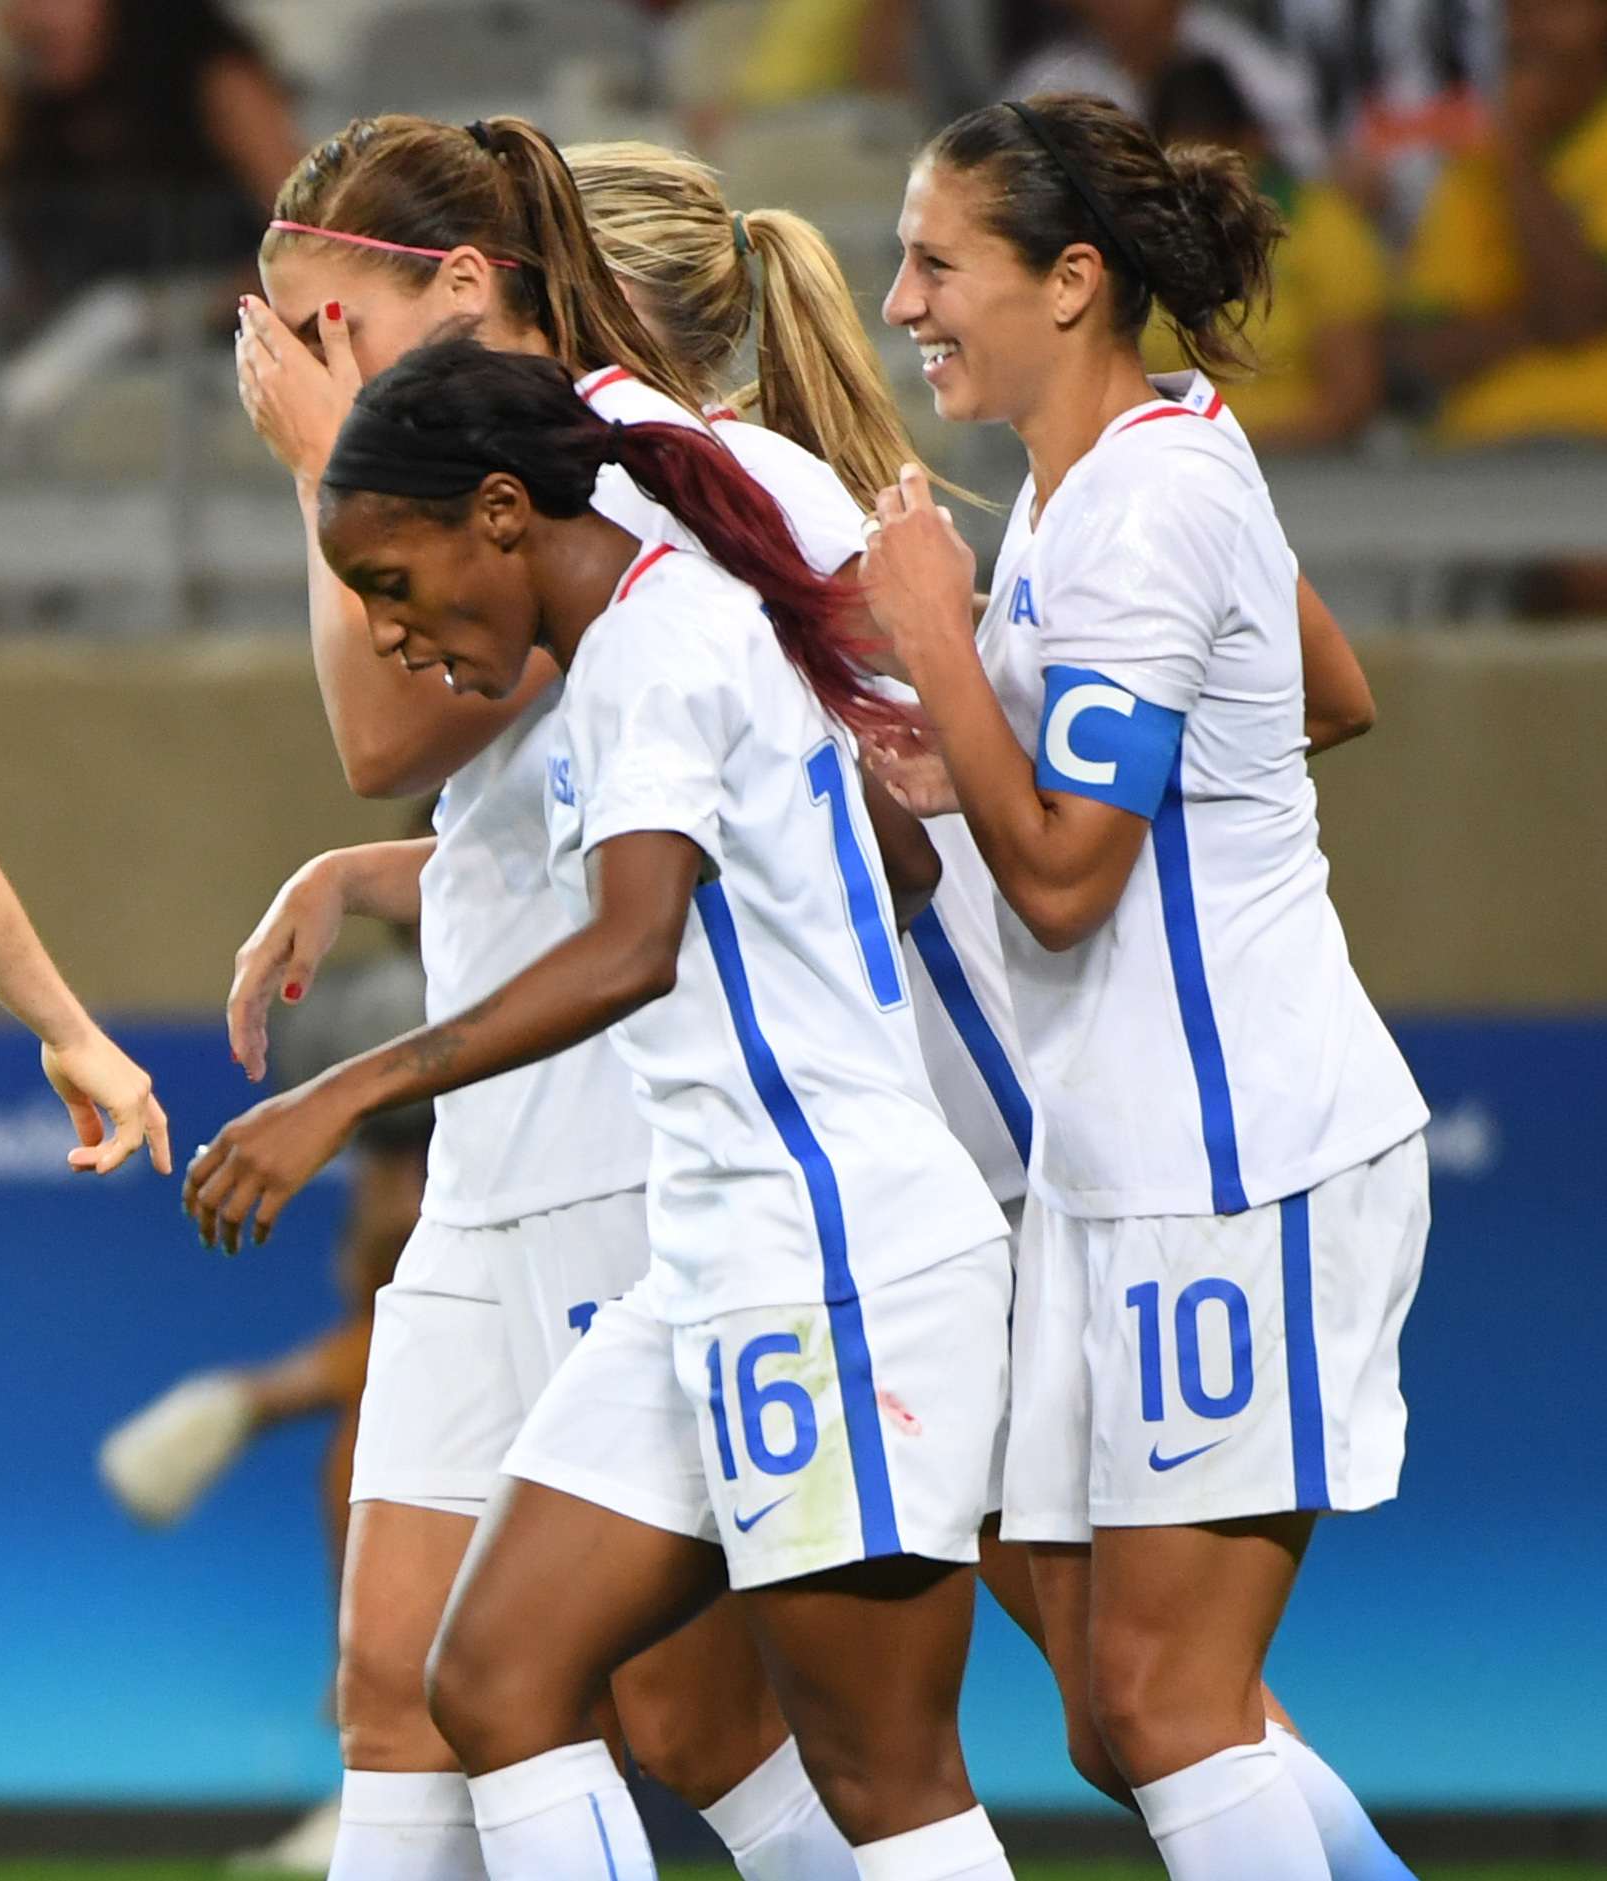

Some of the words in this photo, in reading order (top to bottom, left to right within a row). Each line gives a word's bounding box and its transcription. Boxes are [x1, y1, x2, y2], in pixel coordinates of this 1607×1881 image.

[1045, 683, 1136, 785] C
[706, 1332, 818, 1482] 16
[1126, 1277, 1254, 1422] 10
